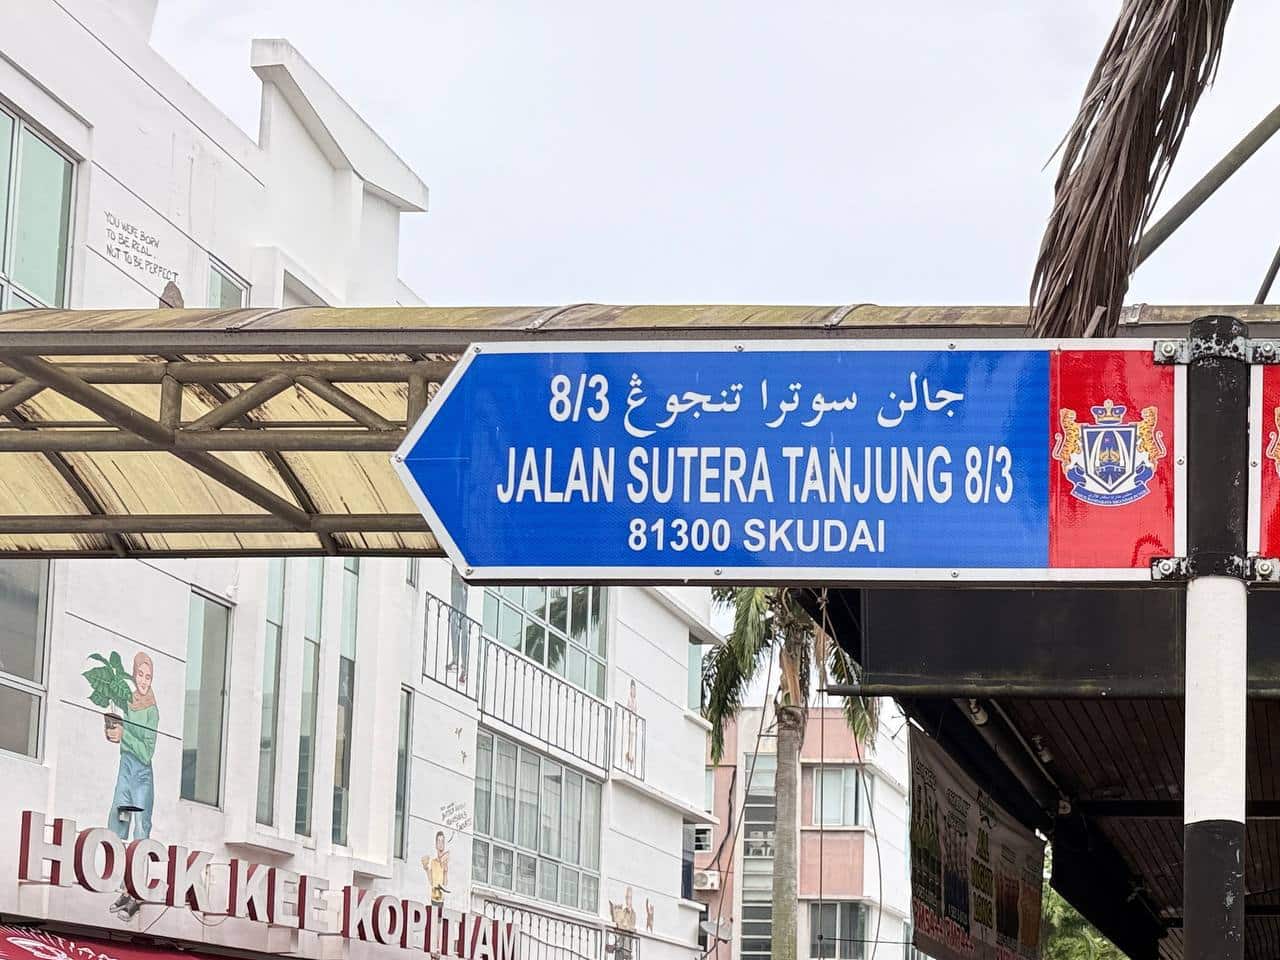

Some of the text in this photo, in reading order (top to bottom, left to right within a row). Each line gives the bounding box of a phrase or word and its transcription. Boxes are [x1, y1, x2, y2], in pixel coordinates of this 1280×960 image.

[104, 210, 120, 228] YOU
[106, 228, 116, 240] TO
[119, 233, 130, 248] BE
[106, 244, 179, 282] NOT TO BE PERFECT
[550, 374, 610, 422] 8/3
[761, 379, 858, 428] سوترا
[878, 372, 964, 428] جالن
[497, 446, 1014, 504] JALAN SUTERA TANJUNG 8/3
[629, 519, 886, 553] 81300 SKUDAI
[19, 810, 213, 911] HOCK
[229, 858, 331, 931] KEE
